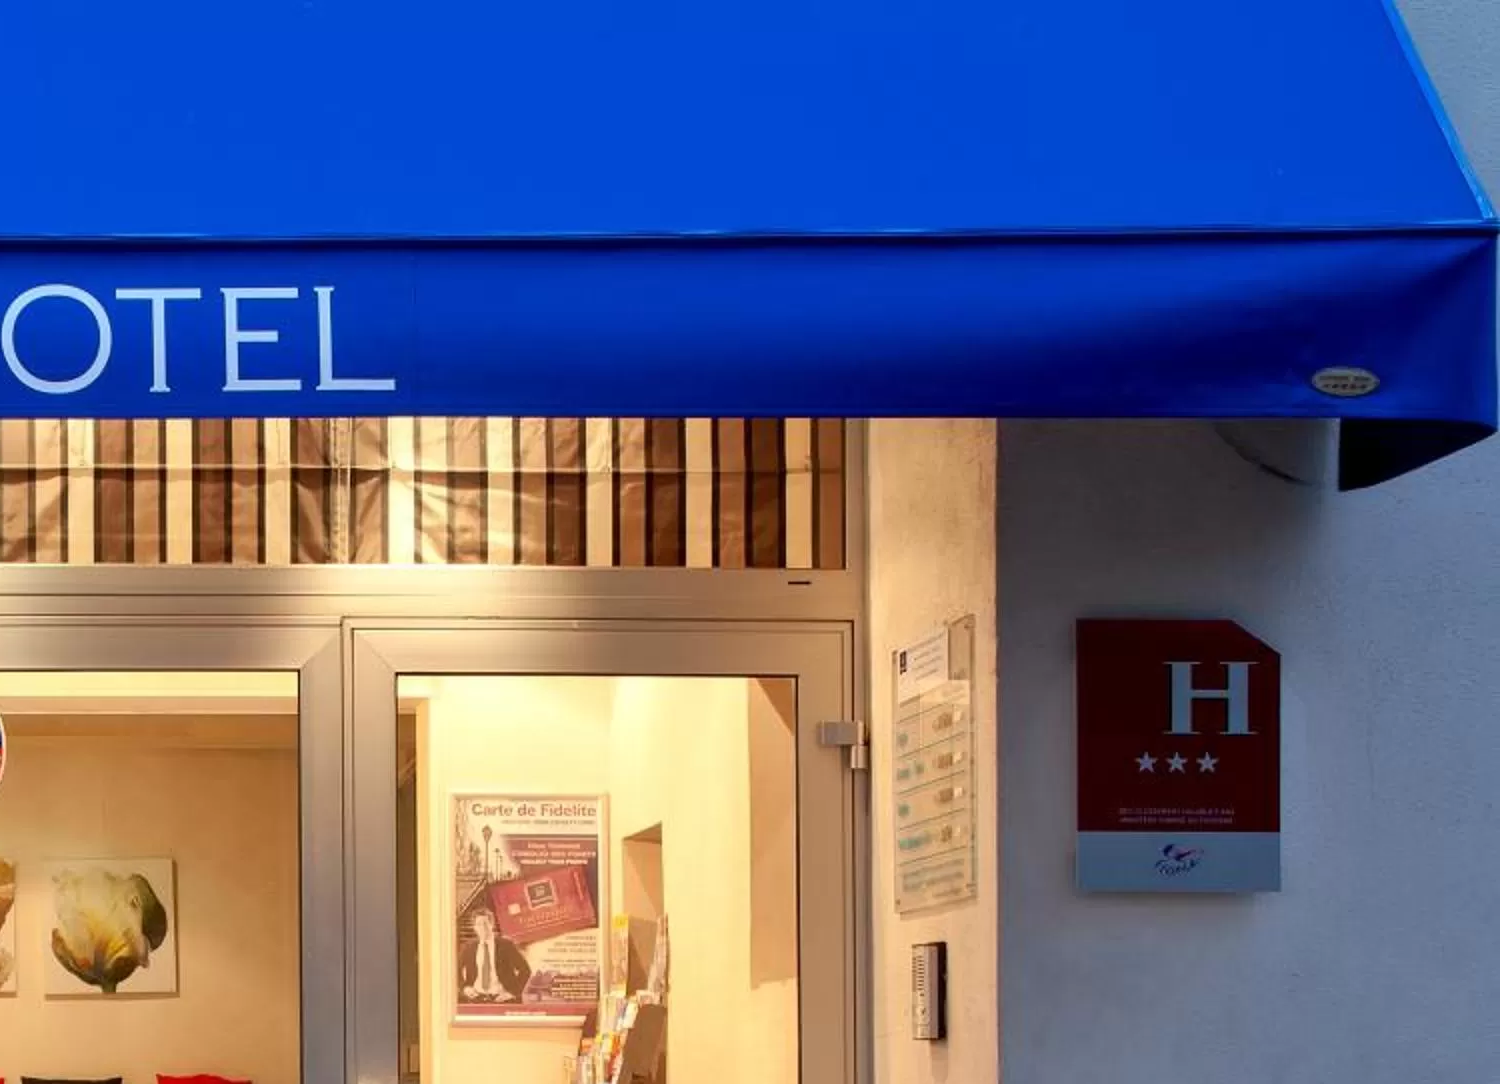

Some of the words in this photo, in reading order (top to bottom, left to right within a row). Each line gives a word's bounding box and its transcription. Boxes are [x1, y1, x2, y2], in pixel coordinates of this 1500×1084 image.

[1162, 660, 1260, 735] H
[471, 803, 513, 817] Carte
[517, 803, 537, 817] de
